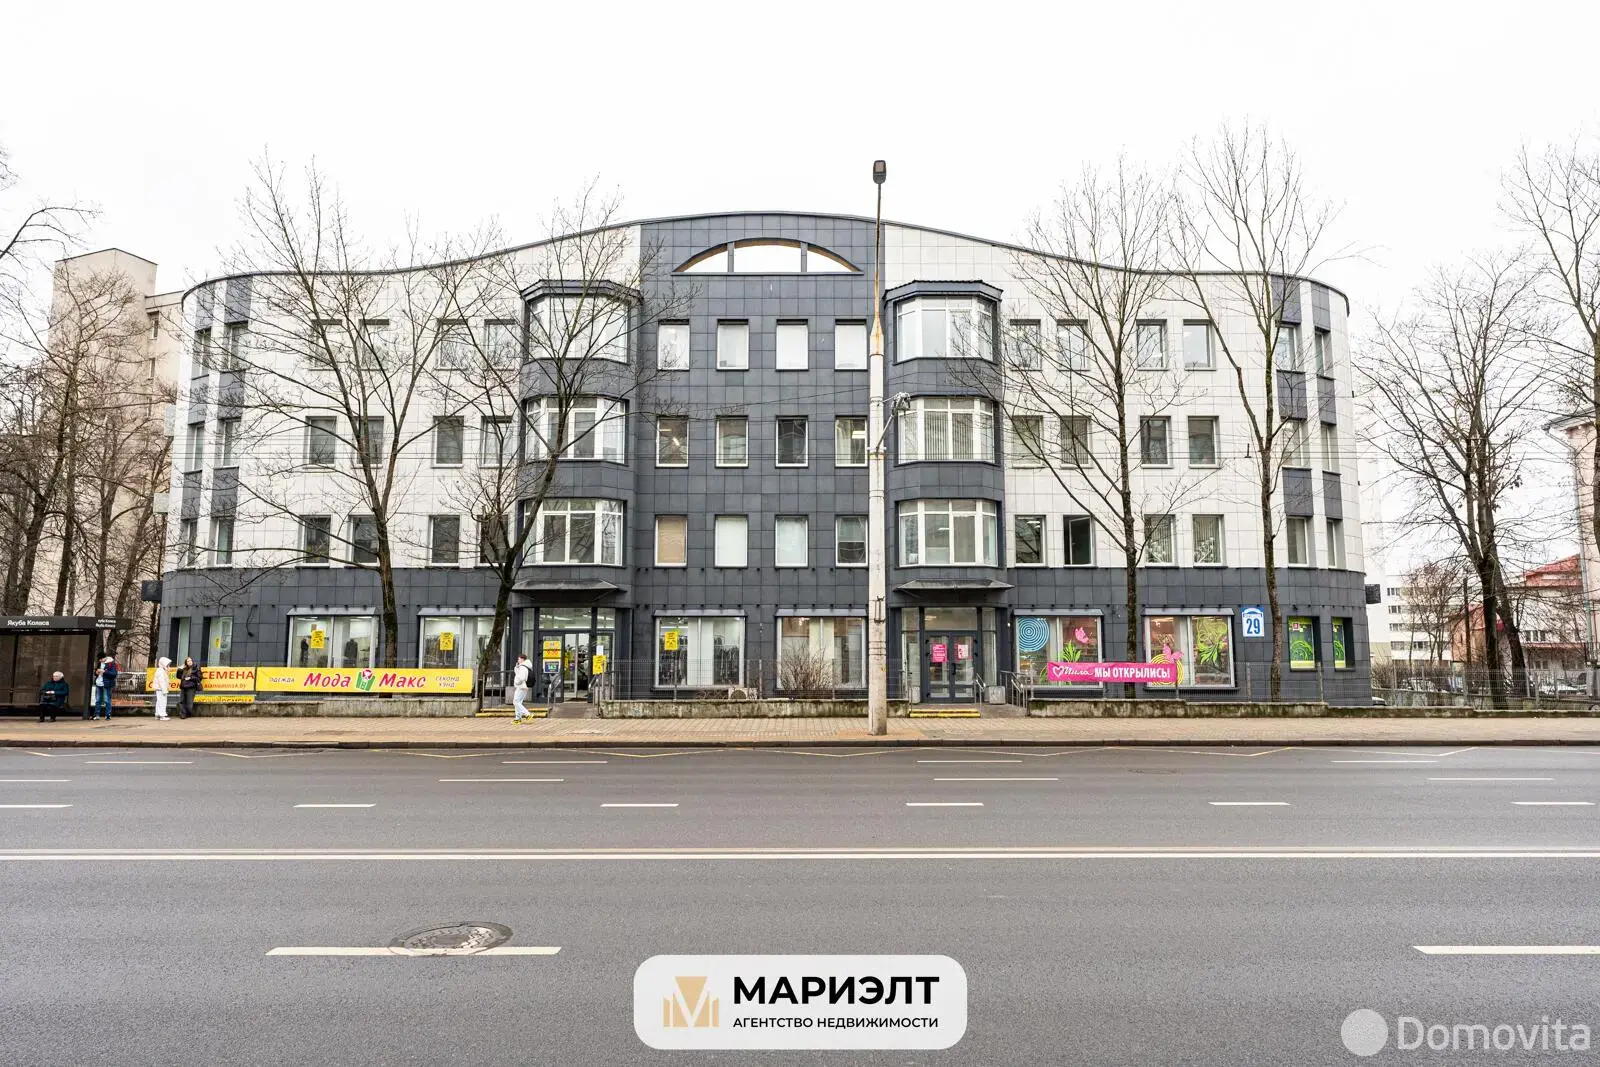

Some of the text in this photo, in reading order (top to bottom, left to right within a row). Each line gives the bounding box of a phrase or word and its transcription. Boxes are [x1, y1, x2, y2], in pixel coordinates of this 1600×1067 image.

[1246, 618, 1261, 634] 29
[303, 672, 427, 688] Мода Макс
[1095, 667, 1111, 678] МЫ
[1112, 667, 1170, 678] ОТКРЫЛИСЬ!
